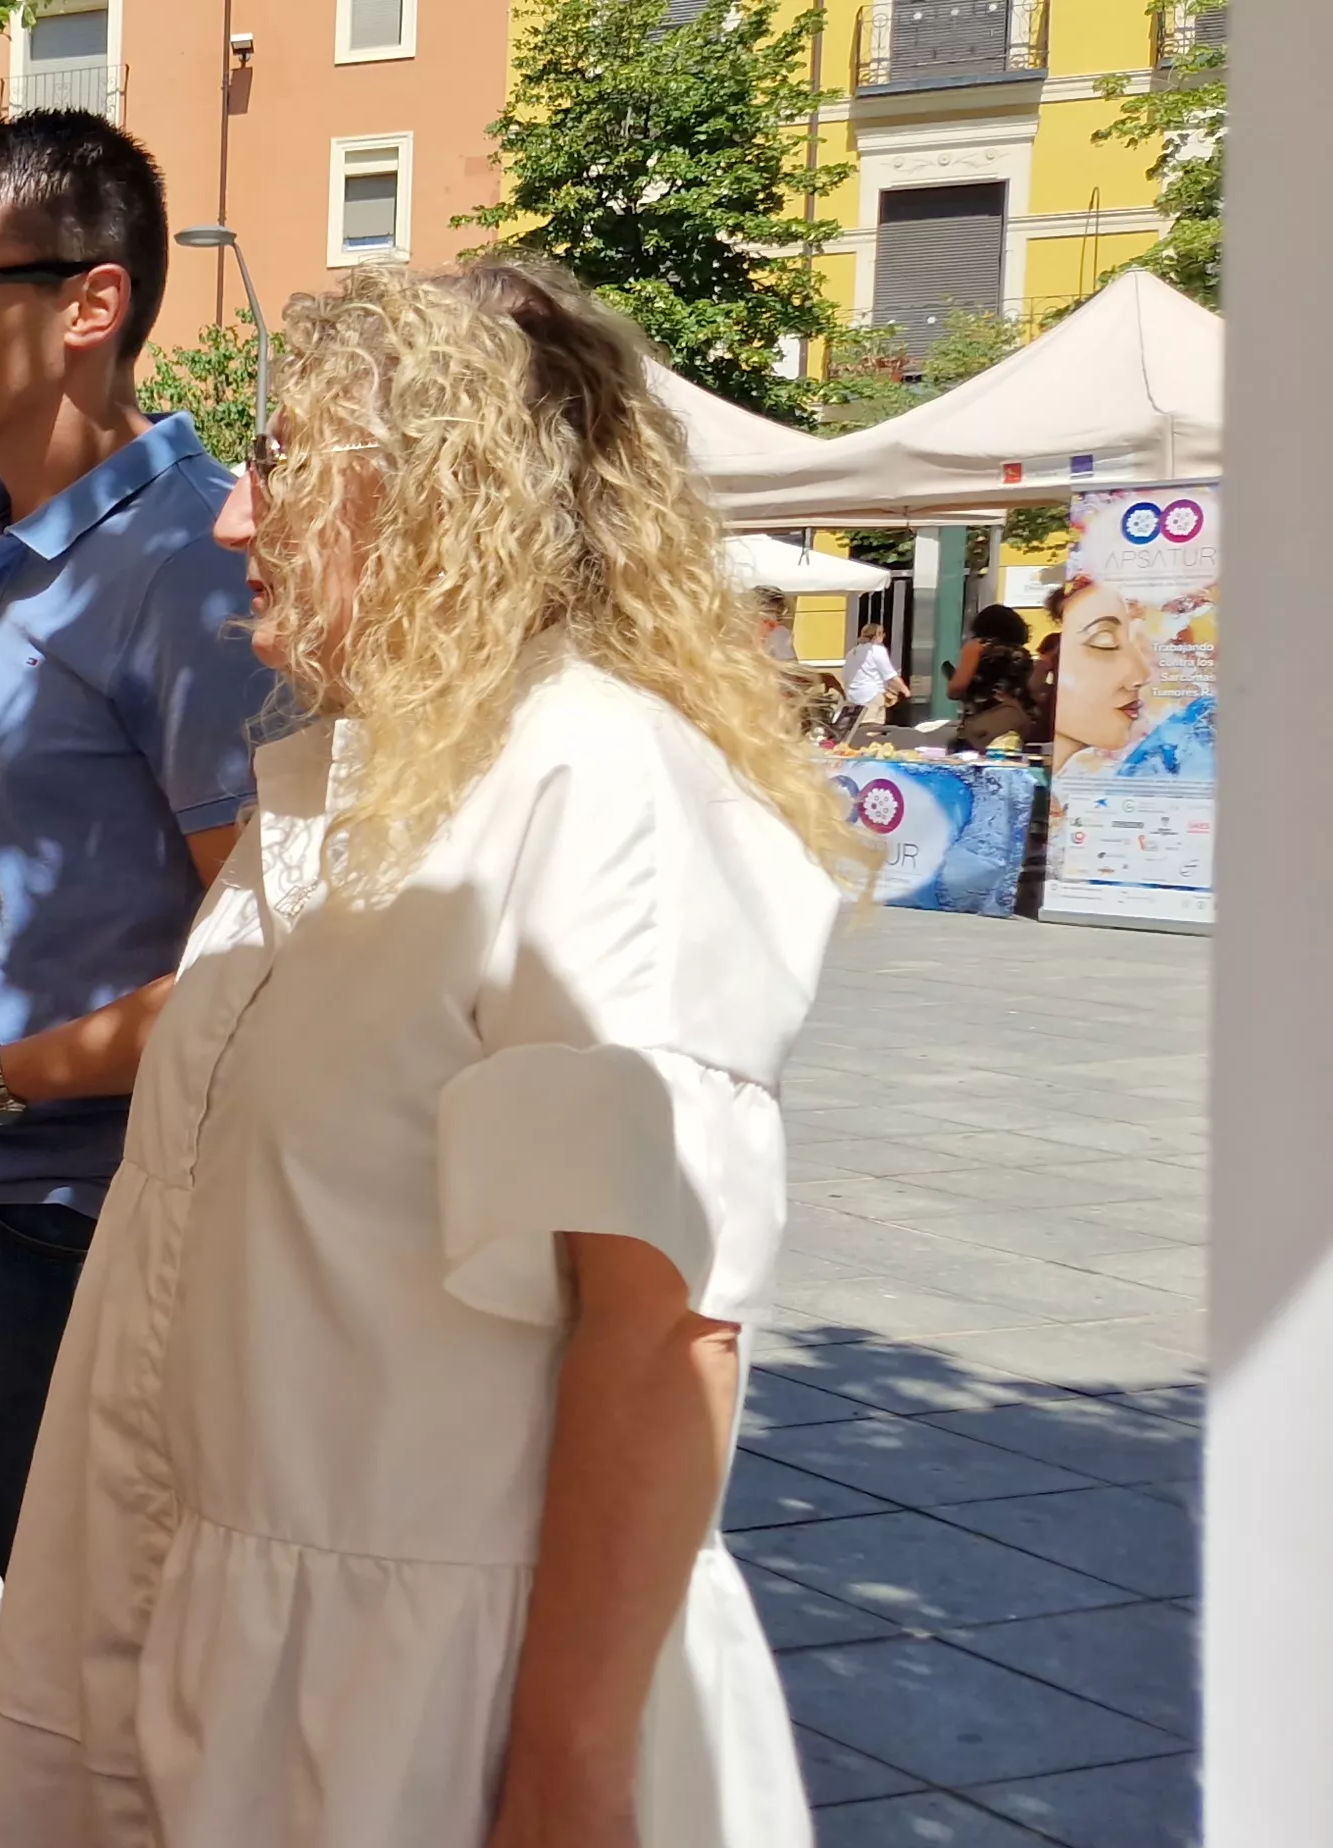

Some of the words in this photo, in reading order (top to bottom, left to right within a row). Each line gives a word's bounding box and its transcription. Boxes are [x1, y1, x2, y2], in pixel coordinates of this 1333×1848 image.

[1105, 547, 1217, 569] APSATUR
[1152, 642, 1214, 653] Trabajando
[1196, 656, 1214, 667] los
